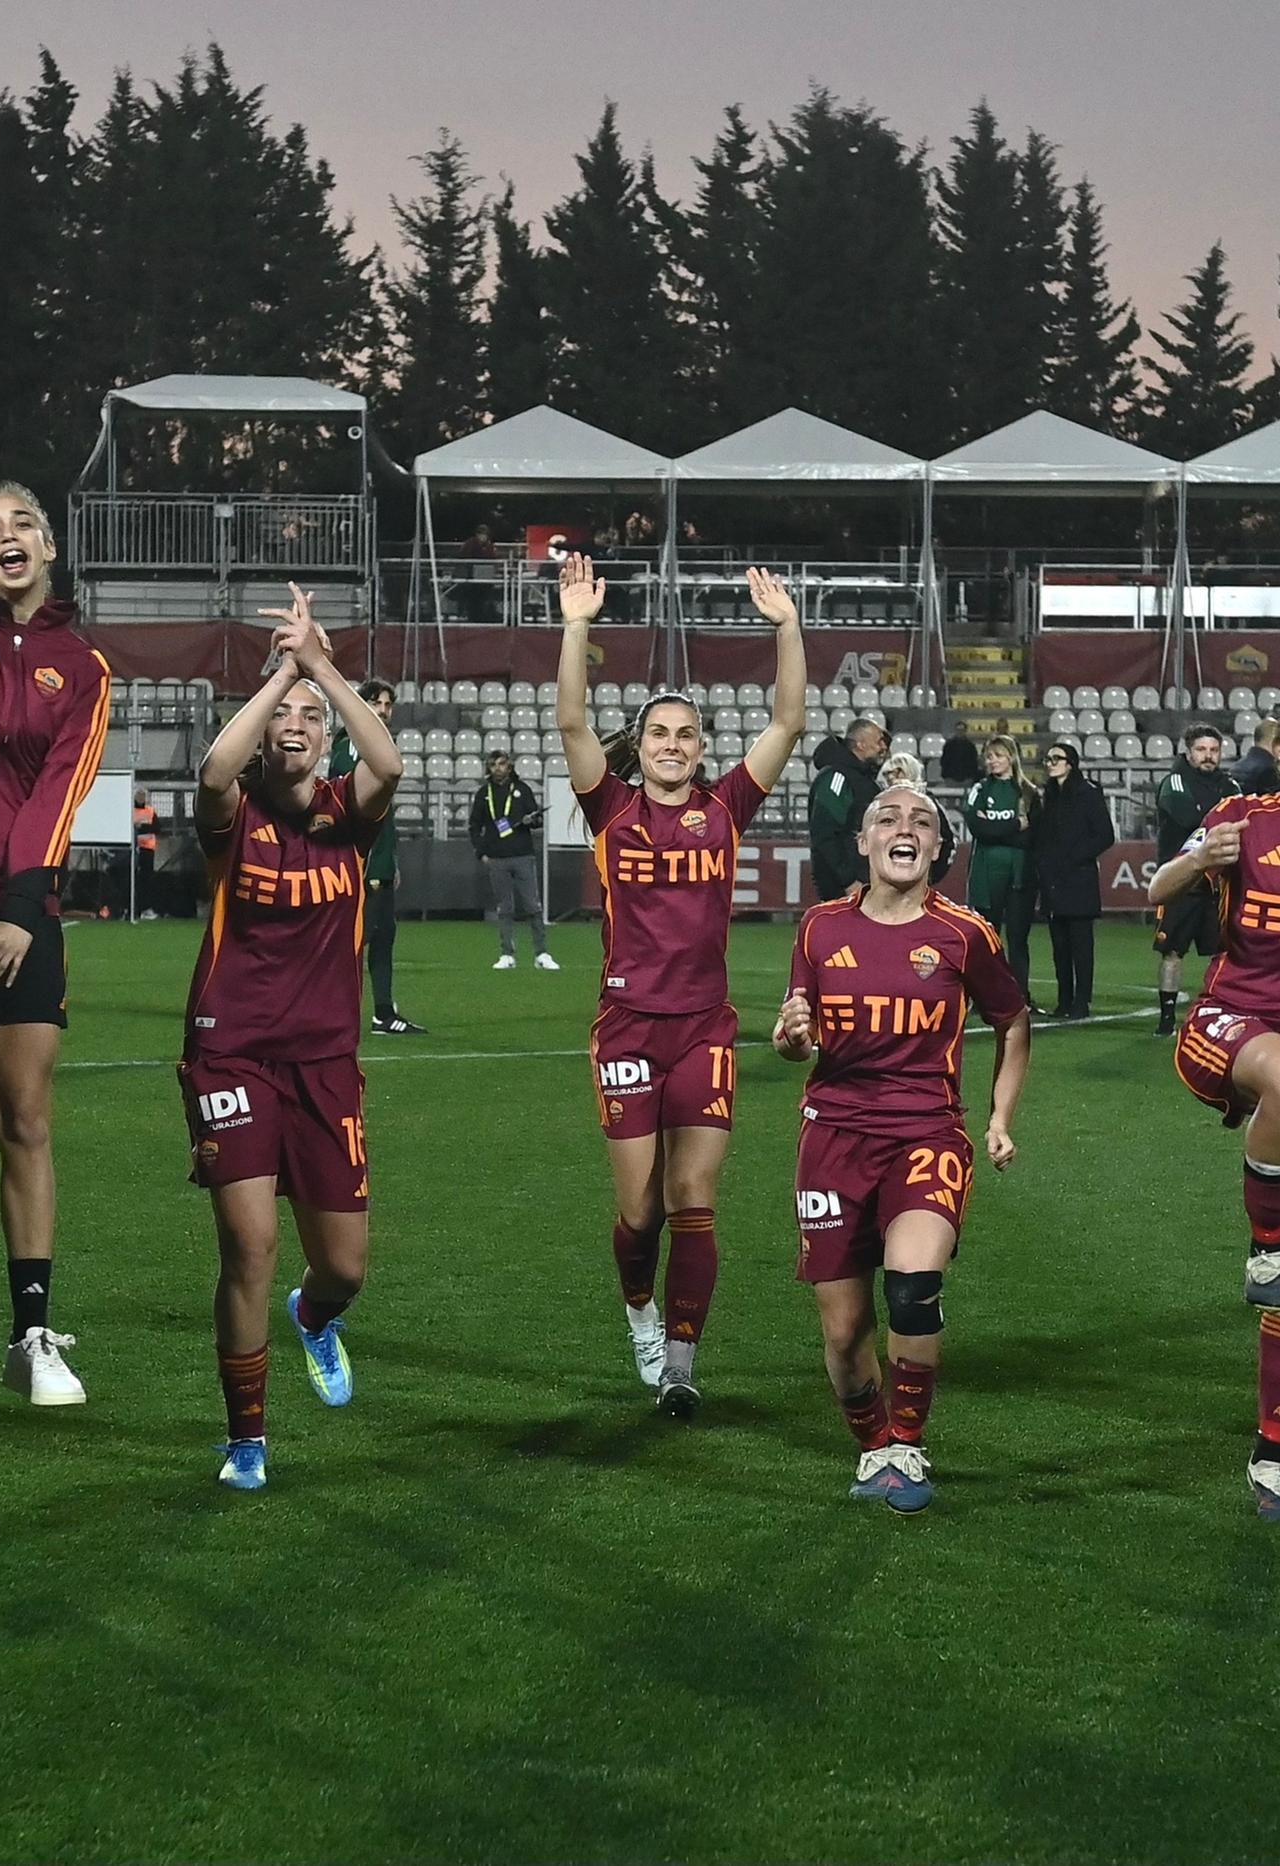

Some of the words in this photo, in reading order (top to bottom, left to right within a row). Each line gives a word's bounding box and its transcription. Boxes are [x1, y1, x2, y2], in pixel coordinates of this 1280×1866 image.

[282, 862, 353, 907] TIM
[662, 848, 725, 883] TIM
[863, 995, 946, 1034] TIM
[599, 1059, 651, 1087] HDI
[708, 1046, 733, 1092] 11
[906, 1147, 963, 1192] 20
[796, 1190, 842, 1219] HDI
